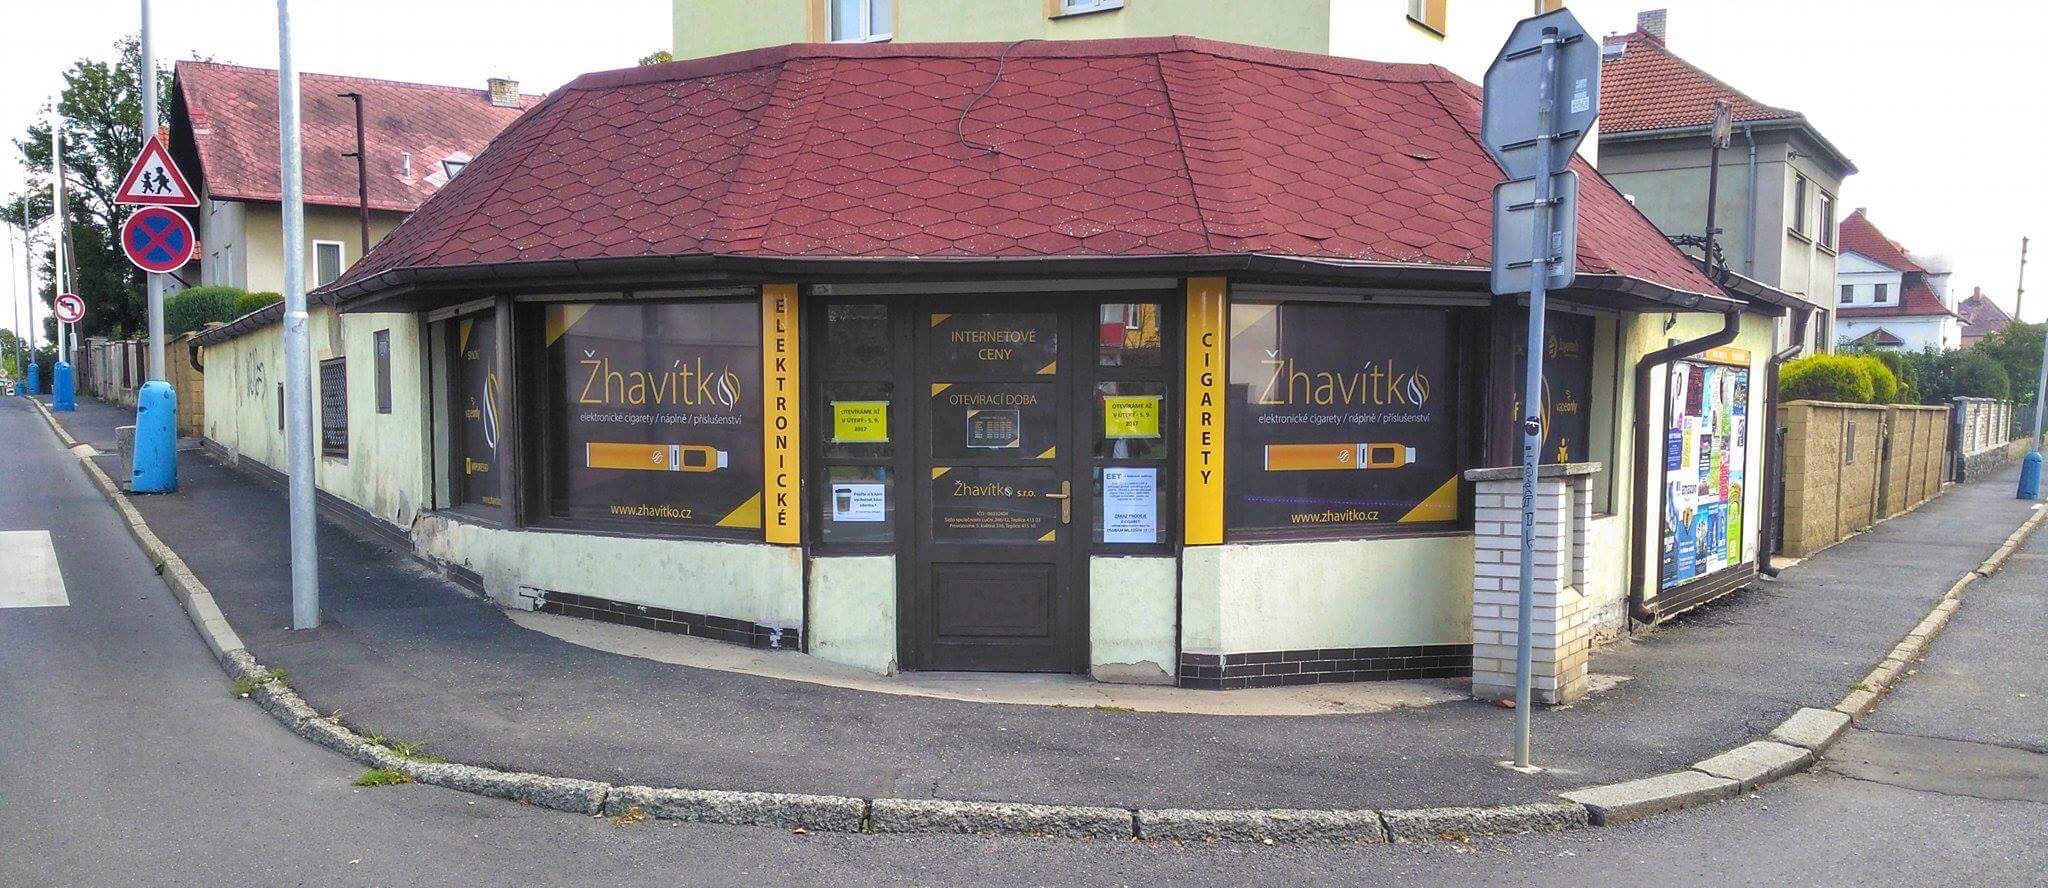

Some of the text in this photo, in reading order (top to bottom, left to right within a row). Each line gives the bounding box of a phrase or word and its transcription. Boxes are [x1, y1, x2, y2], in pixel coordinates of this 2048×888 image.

[951, 328, 1037, 343] INTERNETOVÉ
[978, 348, 1012, 360] CENY
[579, 350, 741, 411] Žhavítko
[1259, 350, 1430, 410] Žhavítko
[949, 393, 1037, 405] OTEVÍRACÍ DOBA
[776, 299, 788, 526] ELEKTRONICKÉ
[1201, 333, 1213, 485] CIGARETY
[580, 411, 623, 422] elektronické
[624, 413, 654, 426] cigarety
[660, 412, 687, 426] náplně
[1258, 412, 1308, 423] elektronické
[1309, 412, 1341, 426] cigarety
[1348, 412, 1376, 425] náplně
[953, 480, 1037, 498] Žhavítko s.r.o.
[610, 504, 692, 519] www.zhavitko.cz
[1291, 509, 1379, 523] www.zhavitko.cz
